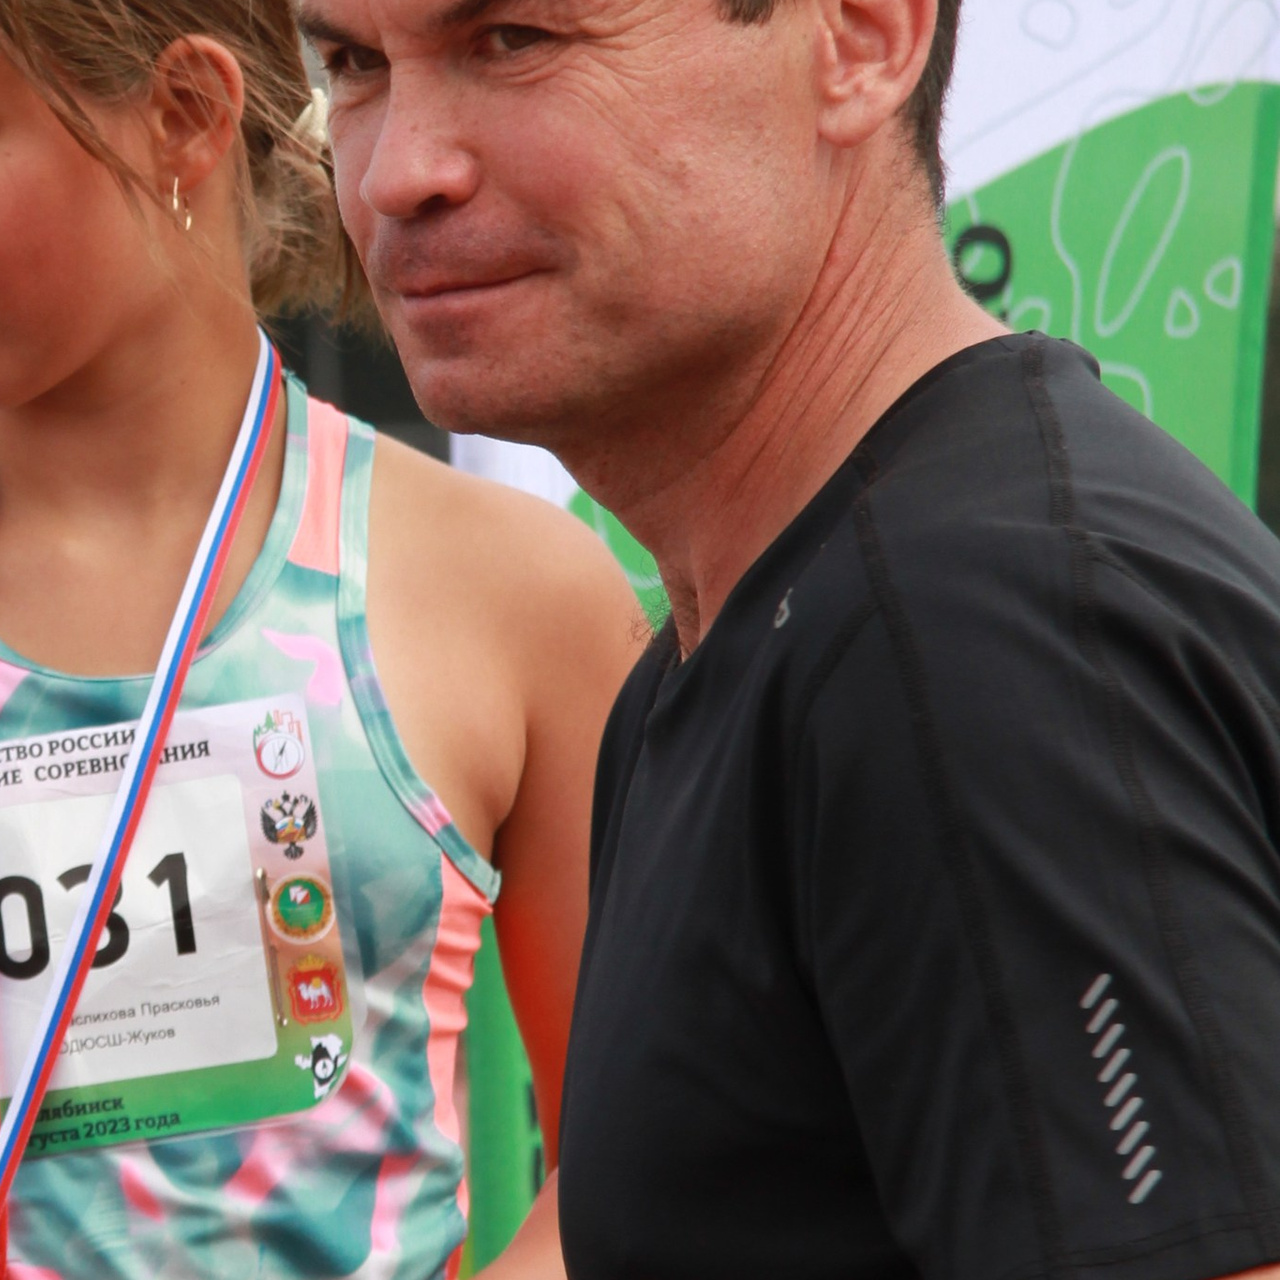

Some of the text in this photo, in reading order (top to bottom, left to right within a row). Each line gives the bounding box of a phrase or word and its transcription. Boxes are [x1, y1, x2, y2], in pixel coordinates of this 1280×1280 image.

[47, 727, 136, 757] РОССИИ
[70, 995, 220, 1027] слихова Прасковья
[38, 1096, 125, 1121] лябинск
[84, 1116, 130, 1138] 2023
[135, 1112, 180, 1132] года
